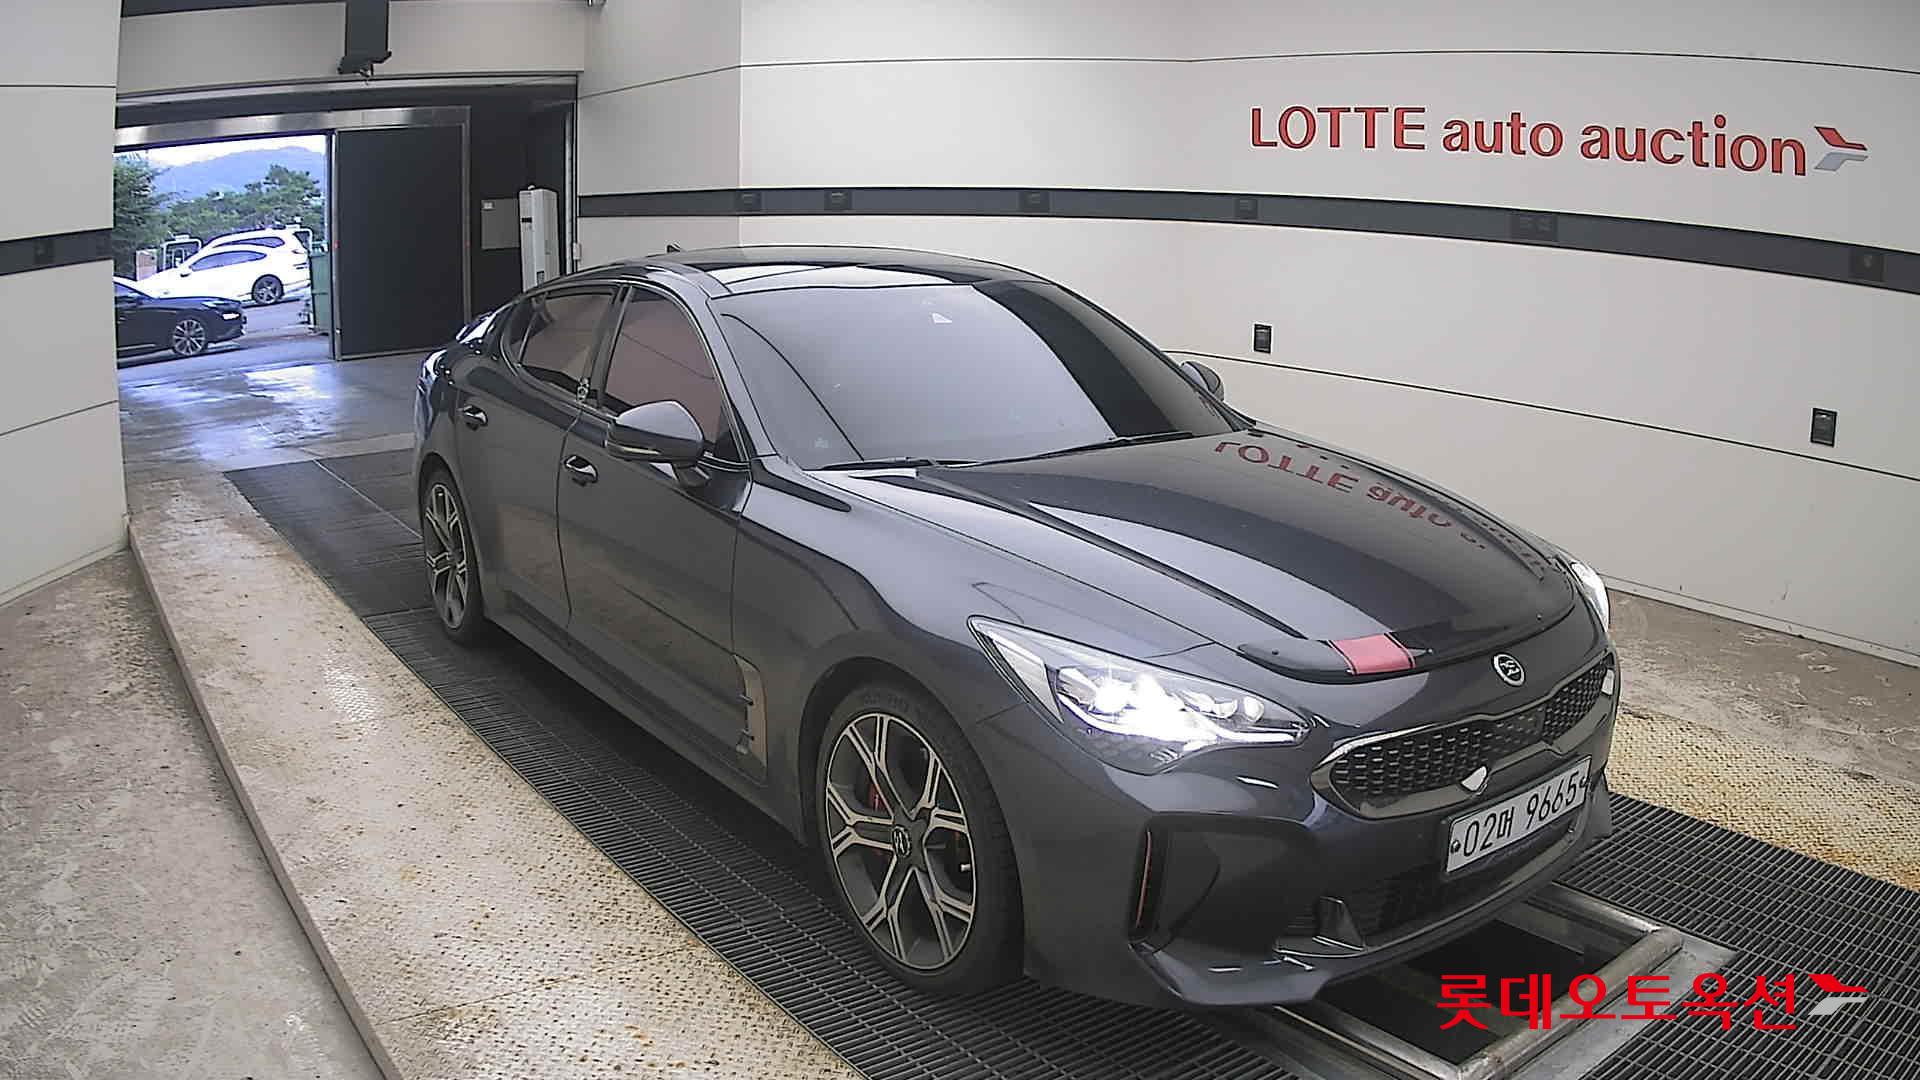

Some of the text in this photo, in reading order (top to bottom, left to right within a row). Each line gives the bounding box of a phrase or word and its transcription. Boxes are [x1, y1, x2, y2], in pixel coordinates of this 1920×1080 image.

[1250, 105, 1807, 177] LOTTE auto auction
[1463, 771, 1580, 857] 02머 9665
